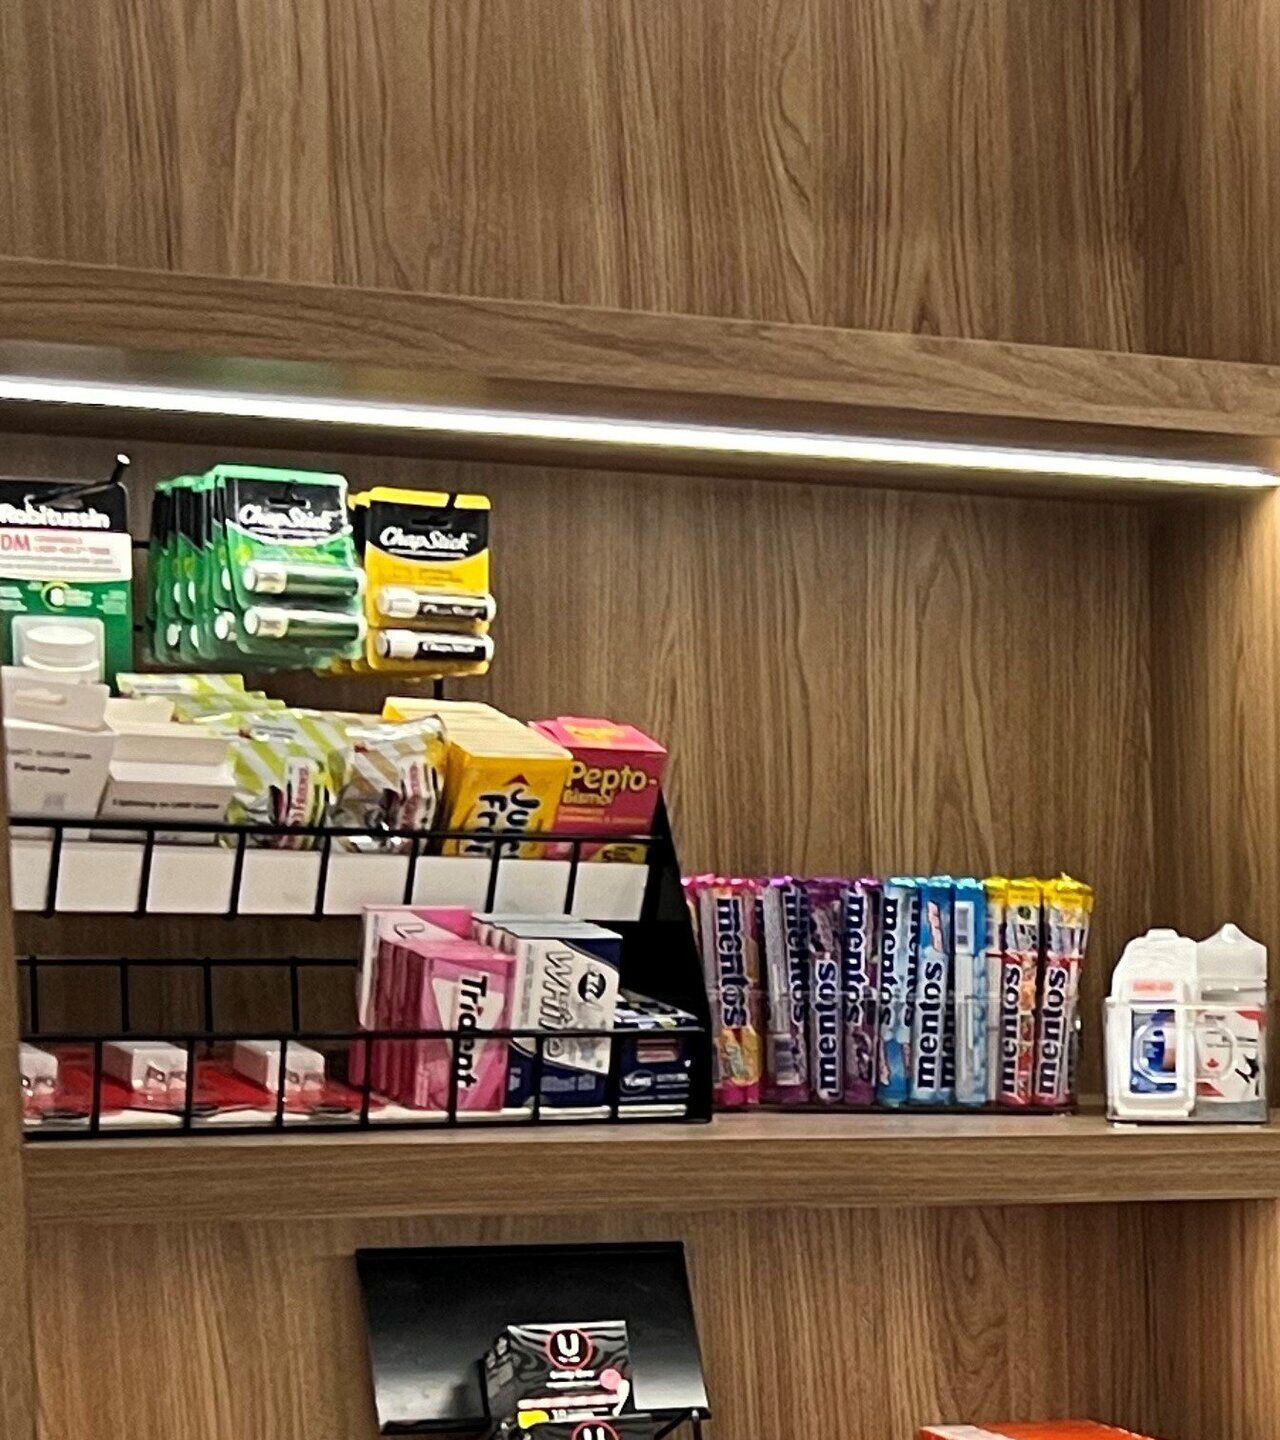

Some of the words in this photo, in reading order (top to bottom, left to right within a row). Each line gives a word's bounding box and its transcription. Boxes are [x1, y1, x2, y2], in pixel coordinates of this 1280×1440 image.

[380, 526, 469, 551] ChapStick
[566, 760, 658, 794] Pepto-
[815, 961, 838, 1090] mentos
[917, 961, 943, 1089] mentos
[1039, 968, 1066, 1096] mentos
